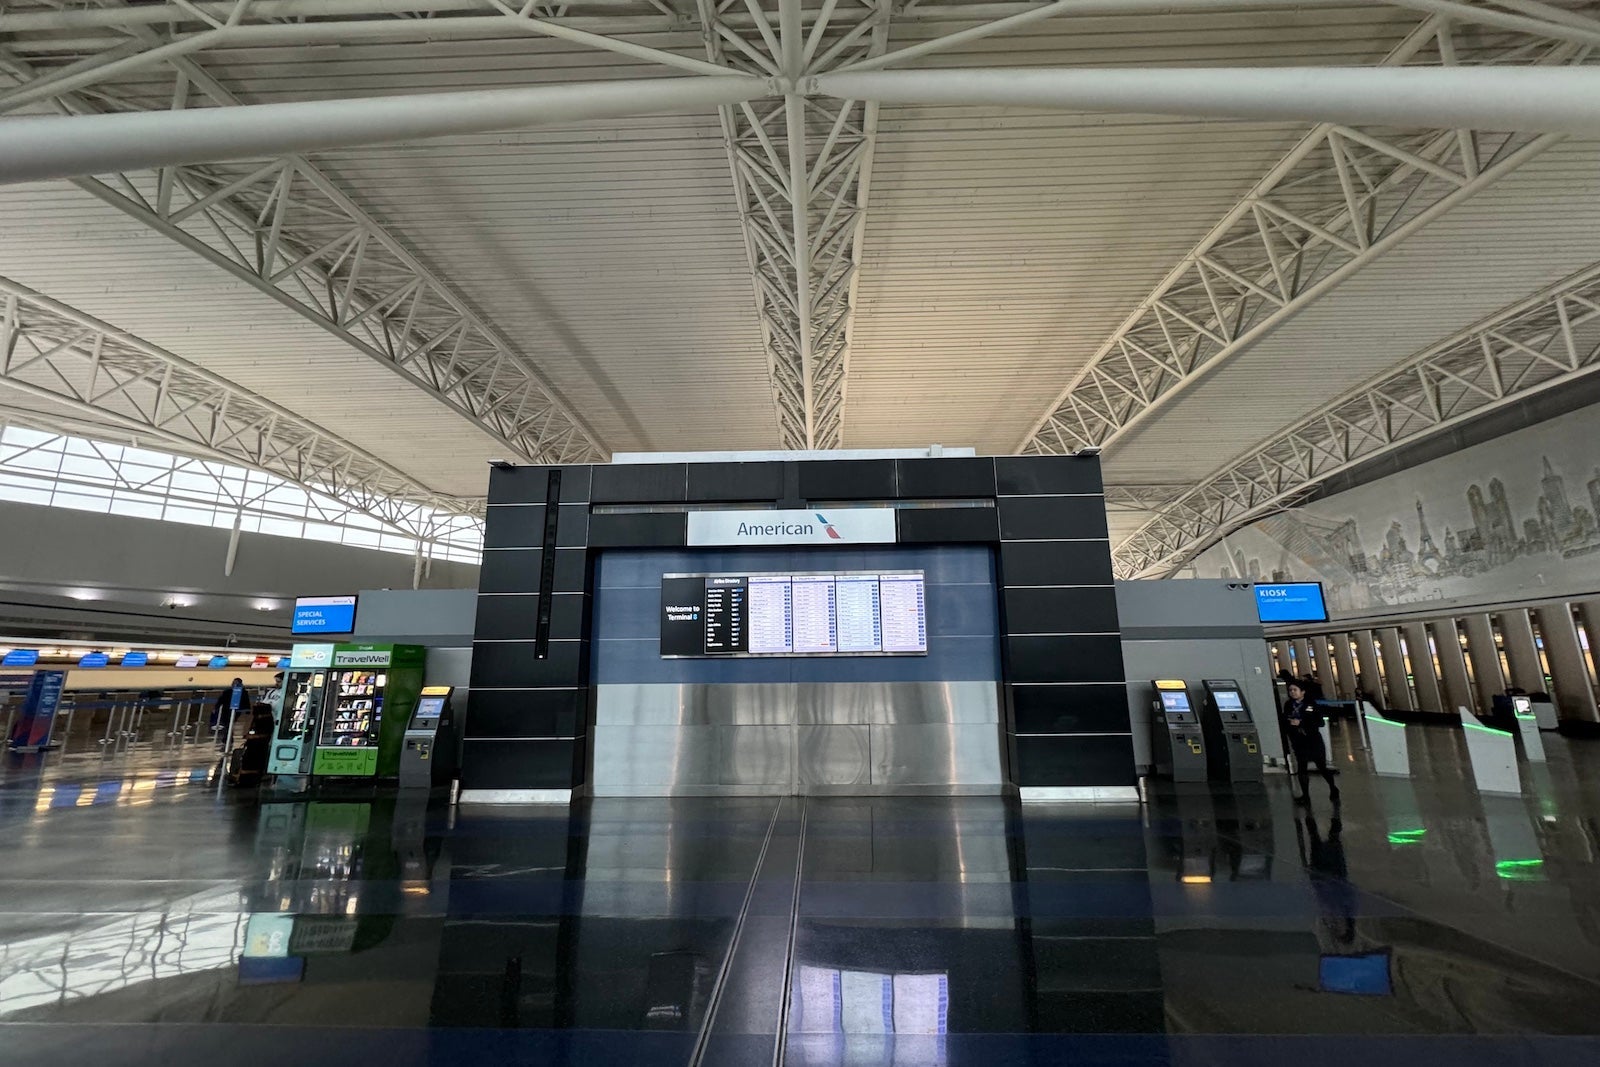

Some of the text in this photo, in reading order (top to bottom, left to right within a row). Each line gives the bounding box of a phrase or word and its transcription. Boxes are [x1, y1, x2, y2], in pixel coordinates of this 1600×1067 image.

[737, 521, 813, 535] American
[1260, 589, 1287, 597] KIOSK
[297, 610, 323, 618] SPECIAL
[296, 618, 326, 626] SERVICES
[336, 655, 389, 663] TravelWell
